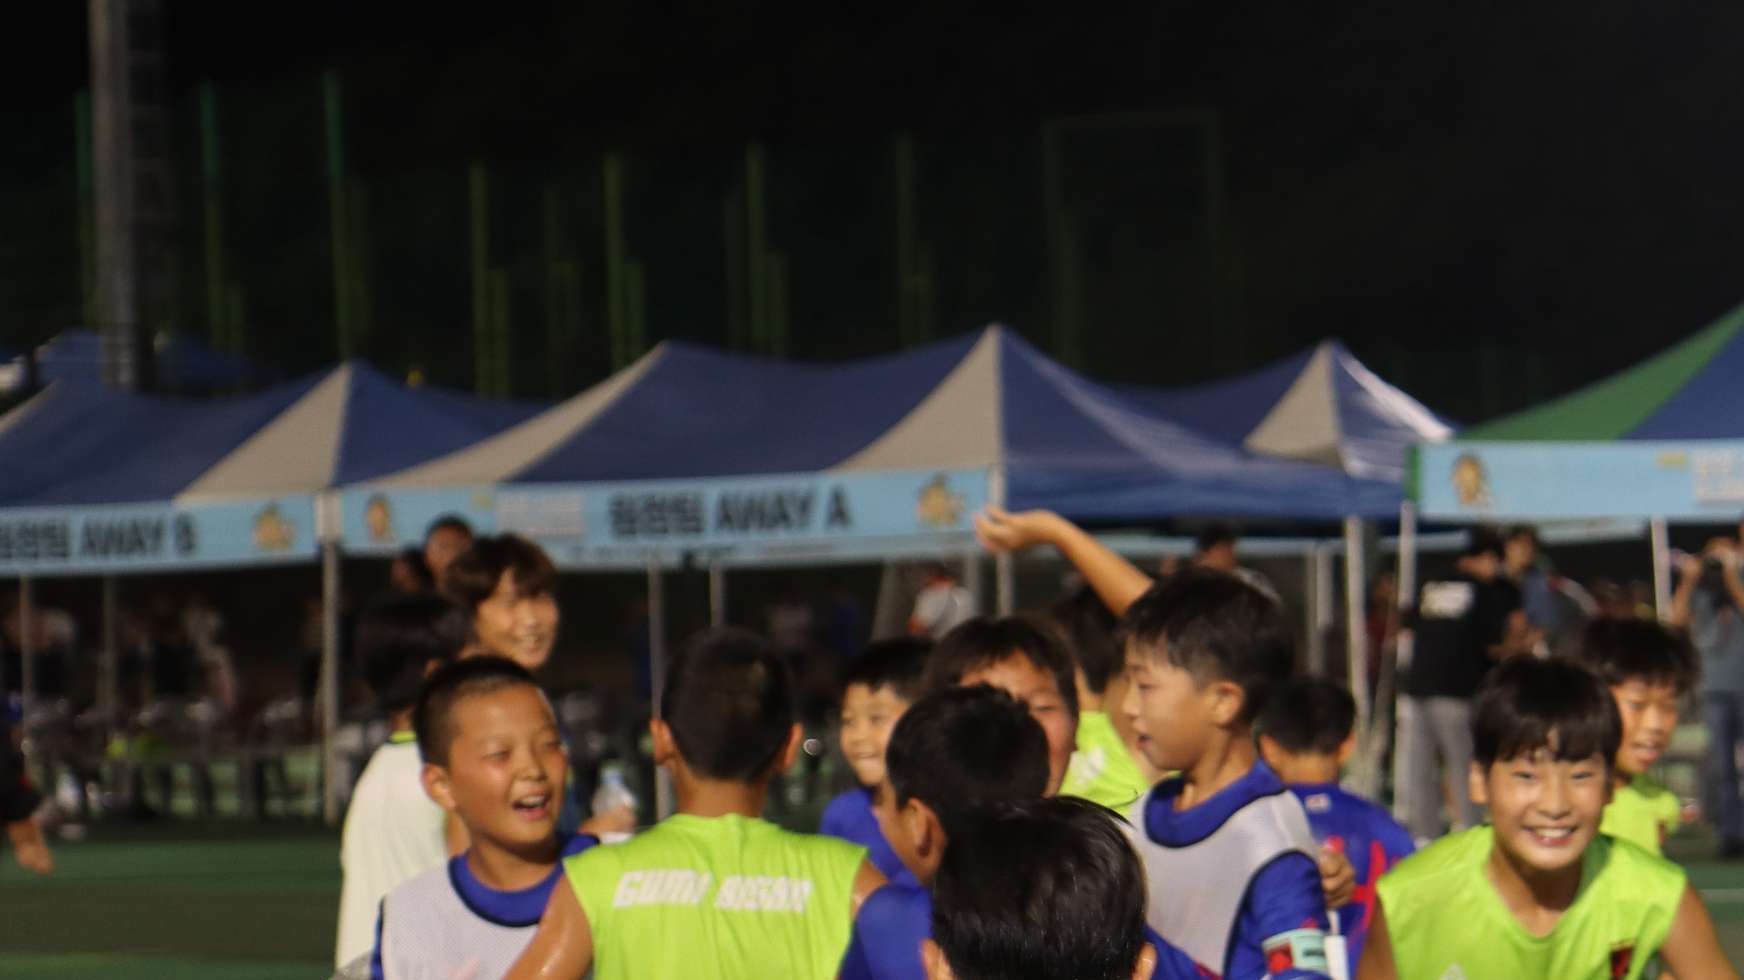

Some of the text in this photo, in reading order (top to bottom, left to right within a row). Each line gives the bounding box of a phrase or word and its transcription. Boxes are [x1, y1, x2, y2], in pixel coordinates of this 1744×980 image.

[713, 488, 818, 532] AWAY
[825, 482, 850, 528] A
[80, 513, 167, 556] AWAY
[612, 868, 713, 909] GUMI
